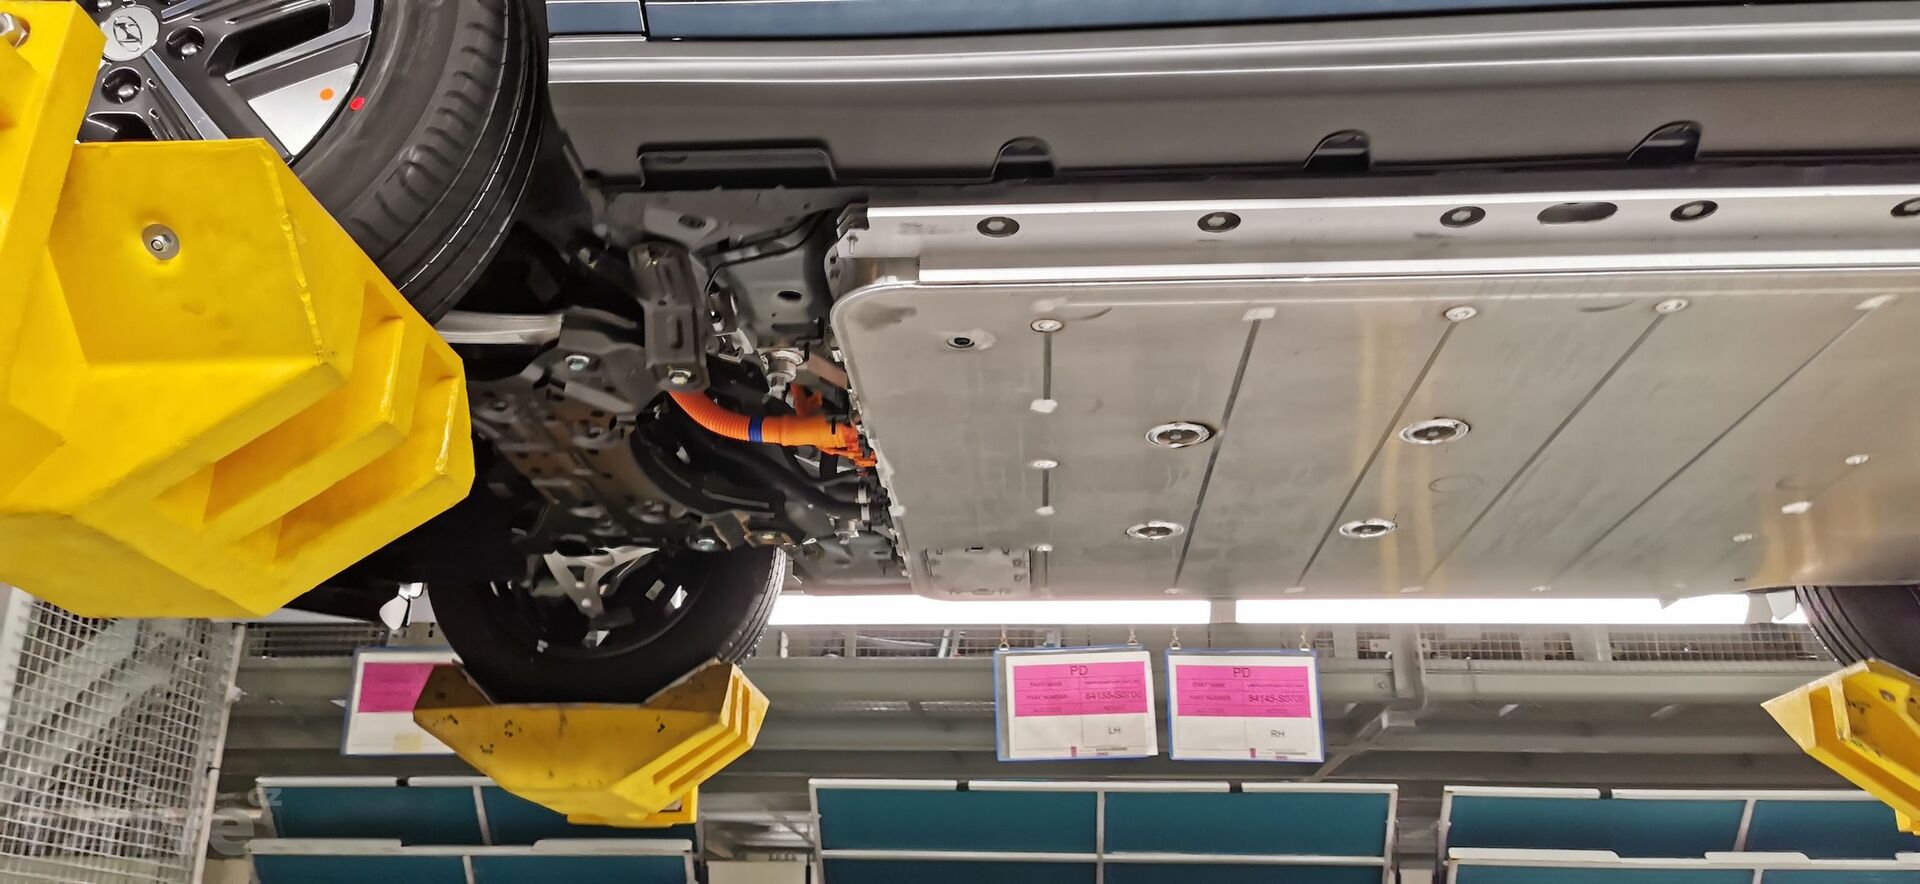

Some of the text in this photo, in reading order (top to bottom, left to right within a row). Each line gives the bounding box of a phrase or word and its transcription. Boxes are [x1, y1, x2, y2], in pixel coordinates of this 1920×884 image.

[1070, 665, 1089, 676] PD
[1233, 667, 1251, 678] PD
[1108, 727, 1121, 735] LH
[1271, 730, 1285, 738] RH
